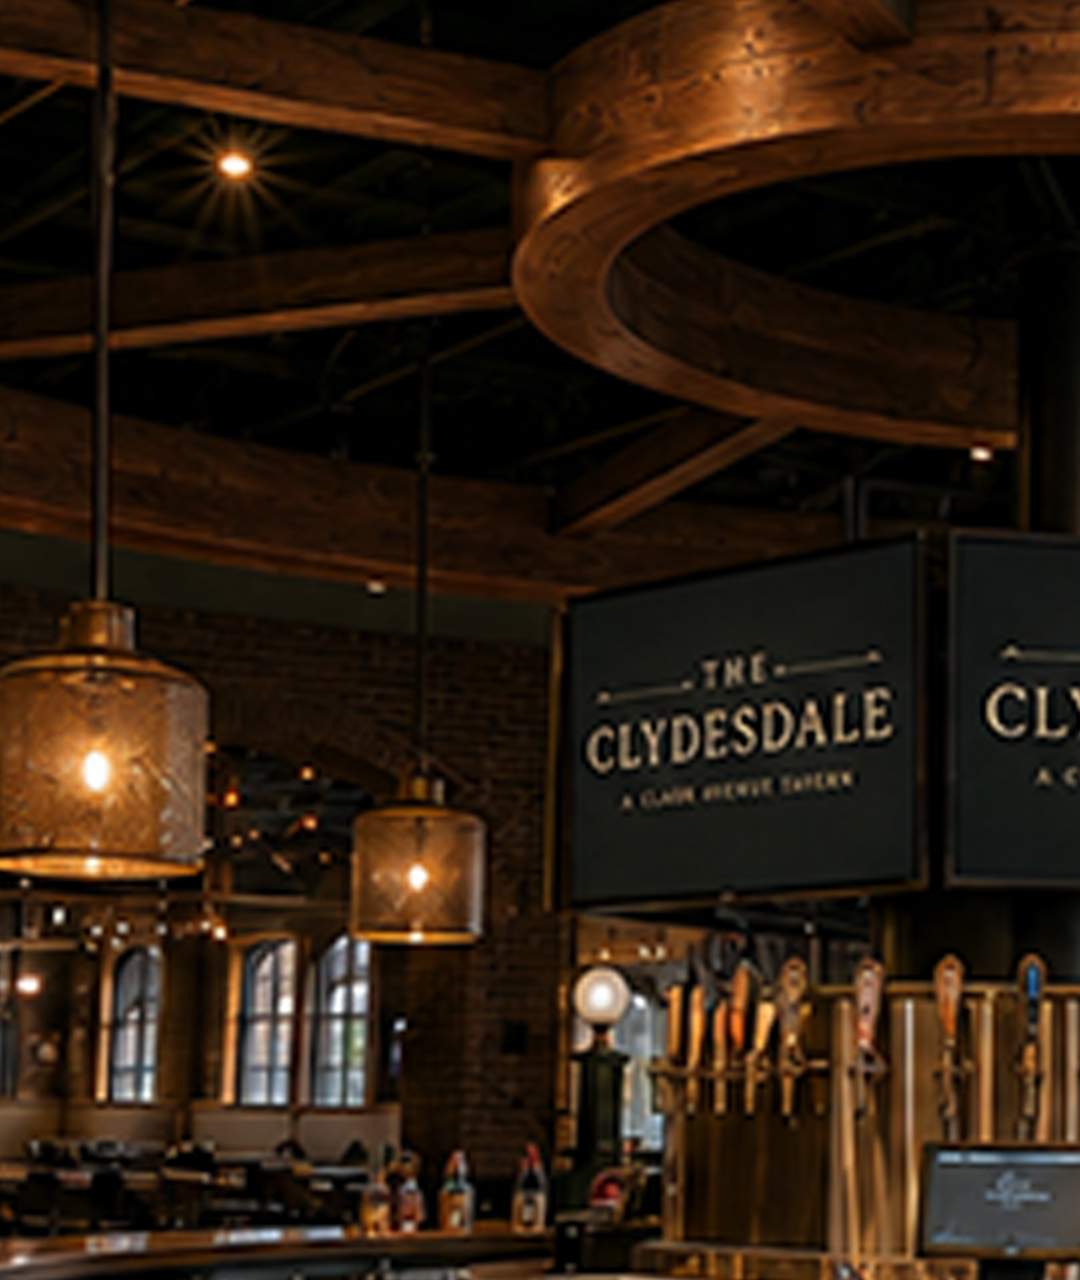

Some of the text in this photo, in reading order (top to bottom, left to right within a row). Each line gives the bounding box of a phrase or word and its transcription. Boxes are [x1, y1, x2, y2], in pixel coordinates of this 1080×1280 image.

[701, 652, 768, 690] THE
[586, 686, 894, 773] CLYDESDALE
[1036, 766, 1053, 787] A
